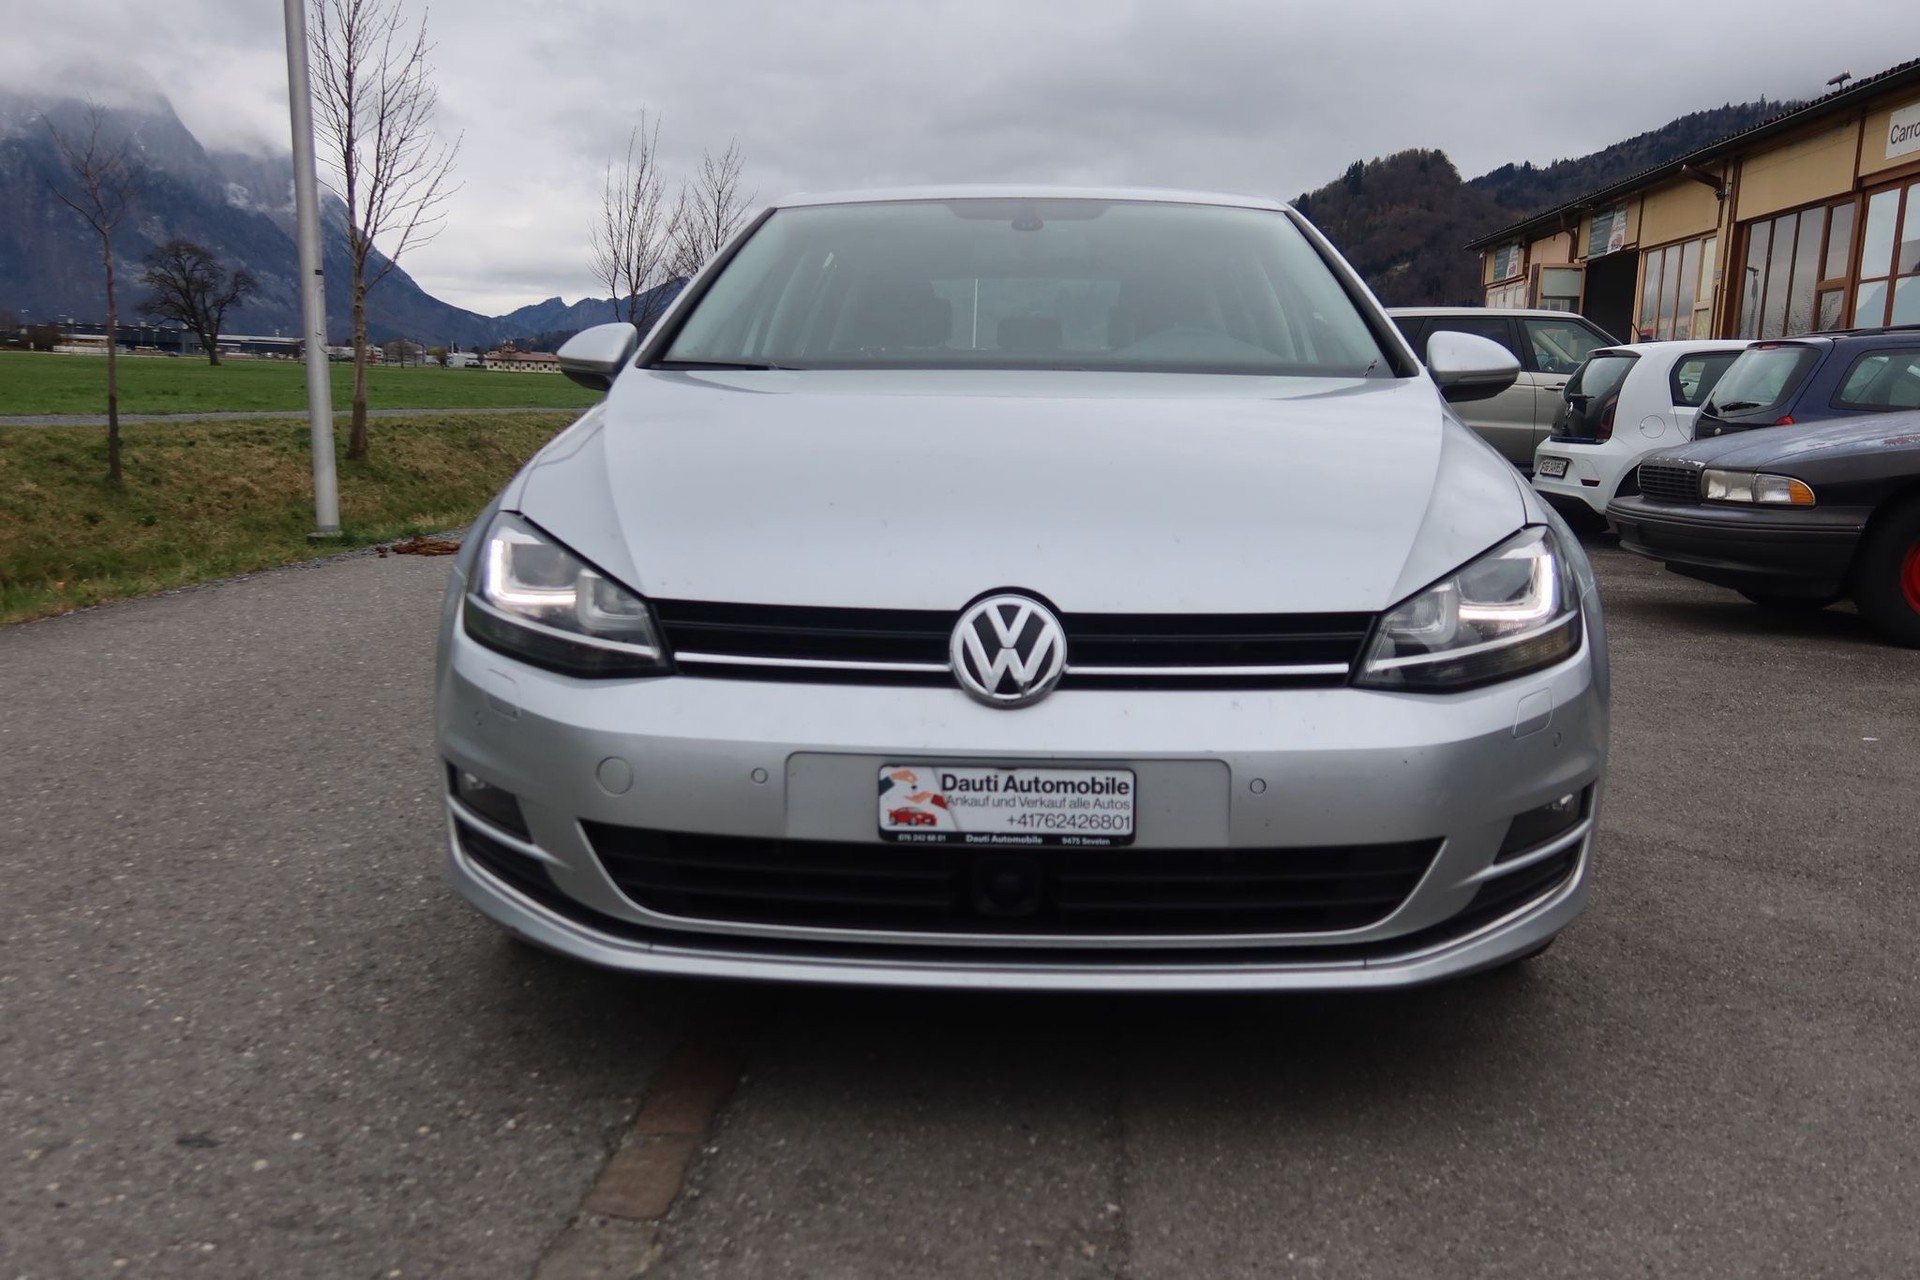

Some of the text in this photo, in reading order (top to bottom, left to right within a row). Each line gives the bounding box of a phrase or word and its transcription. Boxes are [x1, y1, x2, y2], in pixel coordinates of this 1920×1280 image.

[958, 602, 1063, 701] VW
[941, 773, 1131, 796] Dauti Automobile
[946, 795, 1131, 811] Ankauf und Verkauf alle Autos
[1007, 813, 1131, 830] +41762426801
[966, 834, 1043, 844] Dauti Automobile
